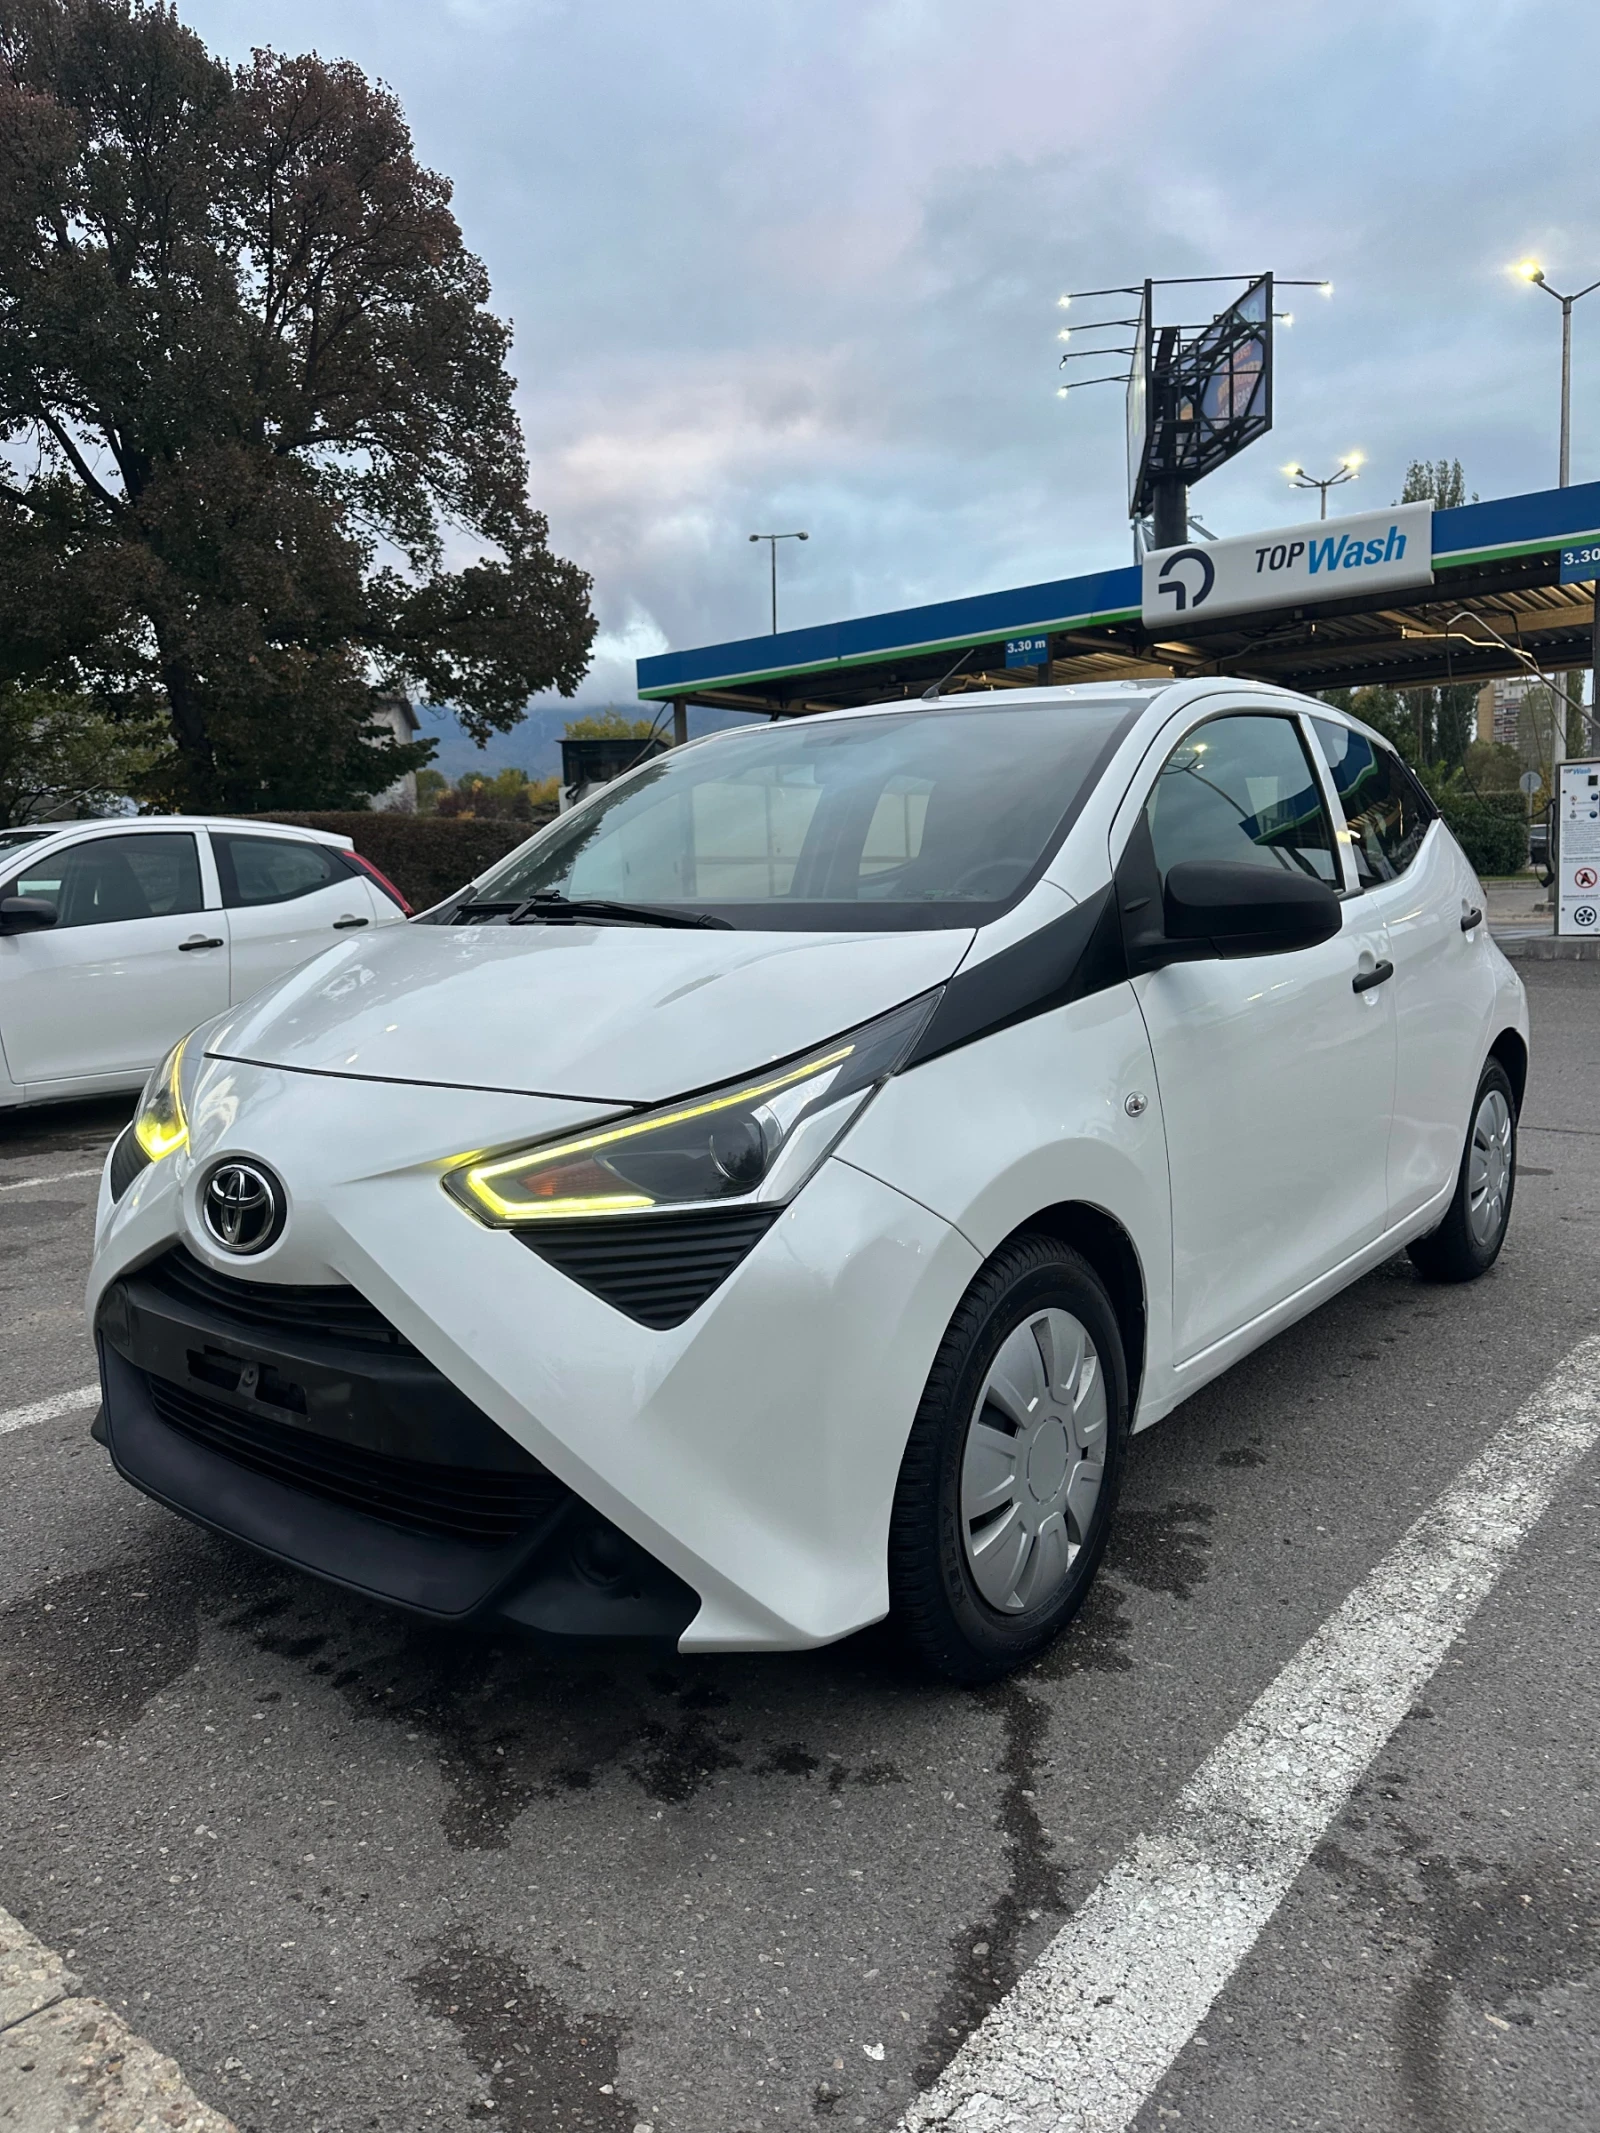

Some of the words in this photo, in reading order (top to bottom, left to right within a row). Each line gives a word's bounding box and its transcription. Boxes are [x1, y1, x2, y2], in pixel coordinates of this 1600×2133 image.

[1564, 548, 1600, 565] 3.30
[1007, 640, 1032, 653] 3.30
[1035, 640, 1046, 649] m
